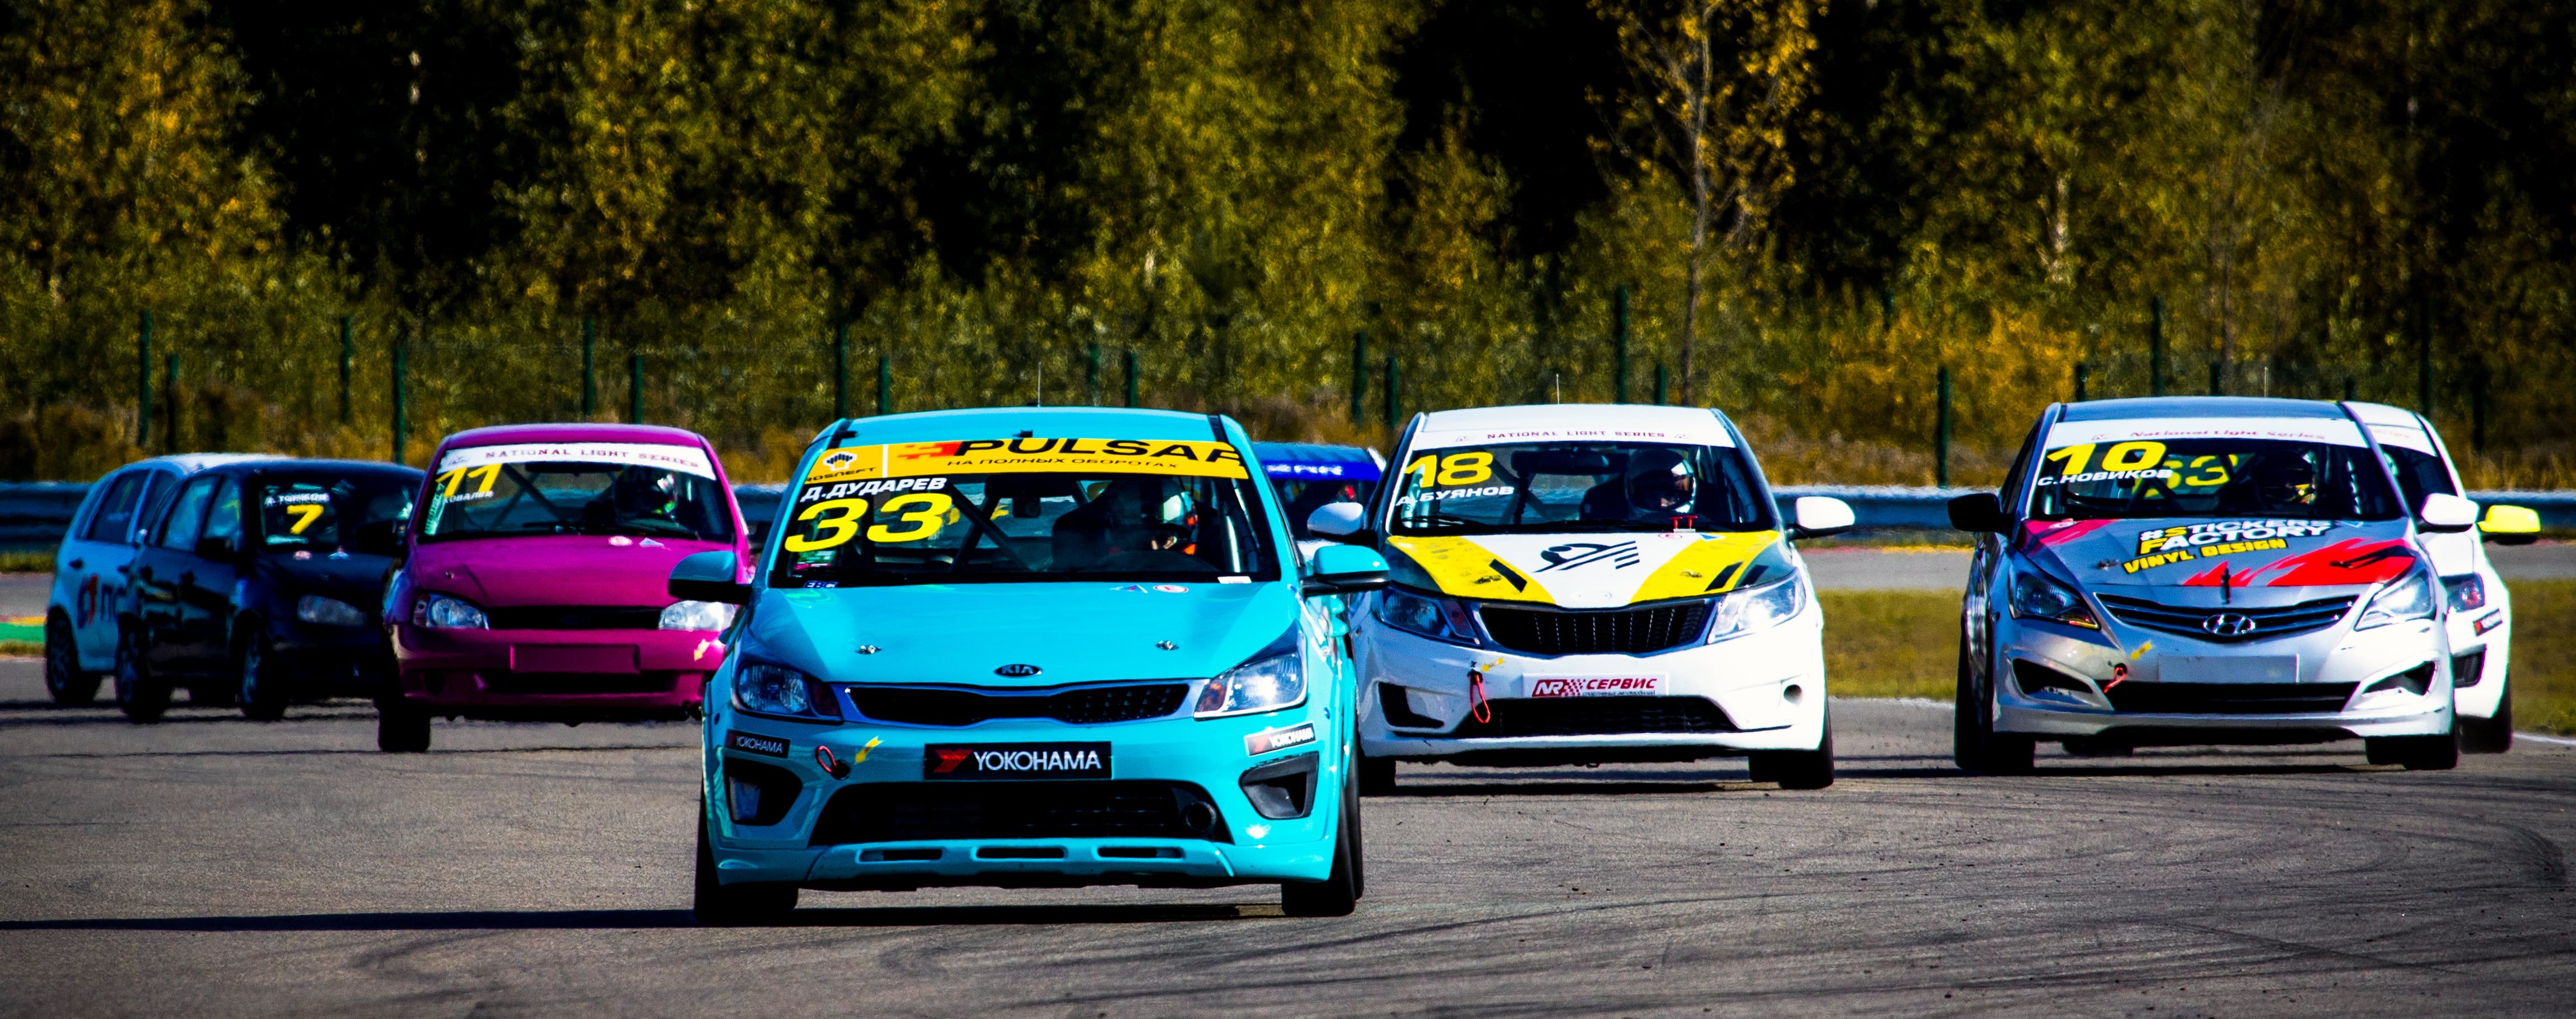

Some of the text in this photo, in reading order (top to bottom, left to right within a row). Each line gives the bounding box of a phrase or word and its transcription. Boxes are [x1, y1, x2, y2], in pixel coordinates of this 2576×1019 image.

[485, 448, 699, 468] NATIONAL LIGHT SERIES
[1072, 458, 1177, 468] ОБОРОТАХ
[2047, 441, 2166, 475] 10
[435, 463, 503, 497] 11
[1404, 451, 1494, 488] 18
[2037, 469, 2174, 486] С.НОВИКОВ
[800, 477, 948, 502] Д.ДУДАРЕВ
[1396, 486, 1515, 506] А.БУЯНОВ
[287, 504, 324, 535] 7
[785, 493, 953, 553] 33
[2140, 519, 2333, 541] #STICKERS
[2140, 525, 2332, 555] FACTORY
[2123, 539, 2286, 574] VINYL DESIGN
[1002, 665, 1034, 674] KIA
[1535, 679, 1657, 695] NR СЕРВИС
[736, 735, 783, 754] YOKOHAMA
[973, 750, 1103, 771] YOKOHAMA
